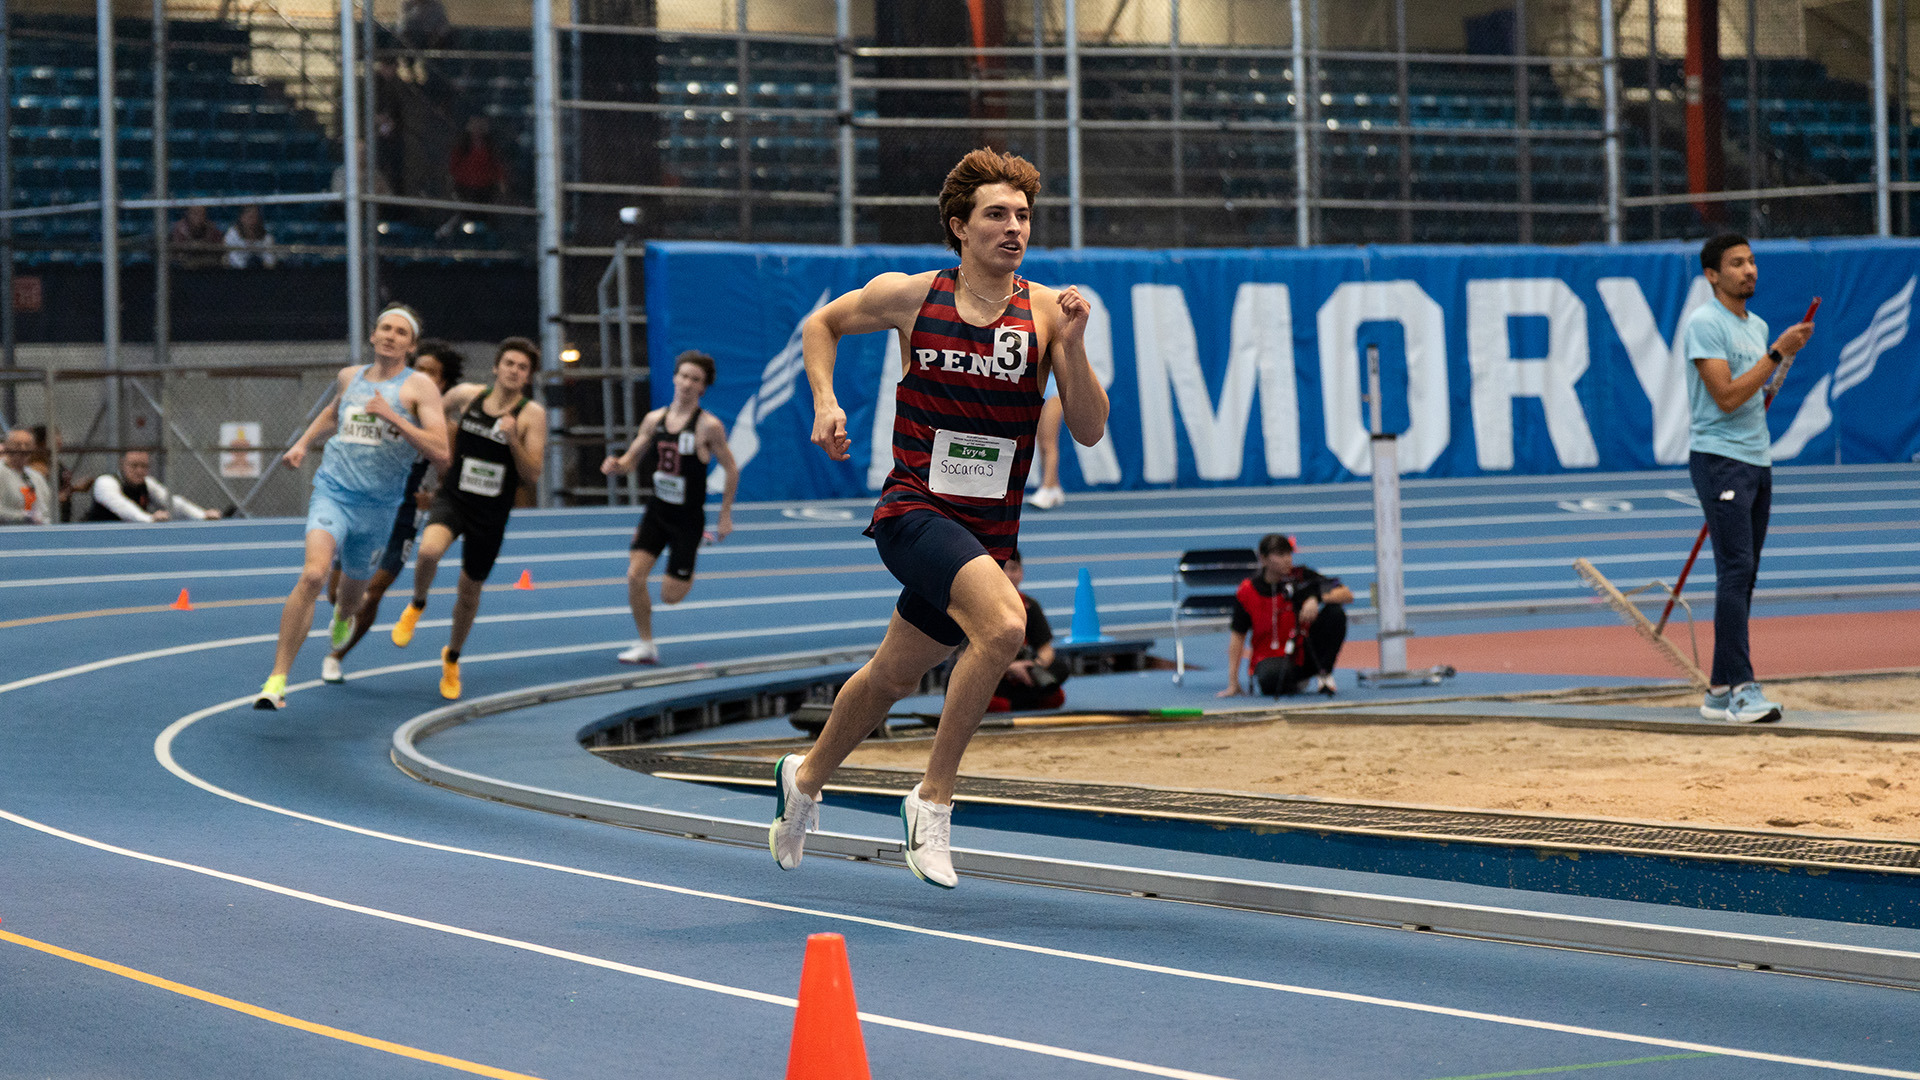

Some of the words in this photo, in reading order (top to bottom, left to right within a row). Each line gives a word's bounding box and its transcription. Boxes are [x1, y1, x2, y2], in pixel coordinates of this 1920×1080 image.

[997, 331, 1022, 370] 3
[867, 276, 1715, 490] MORY
[962, 447, 979, 458] Ivy
[941, 460, 994, 477] Socarras
